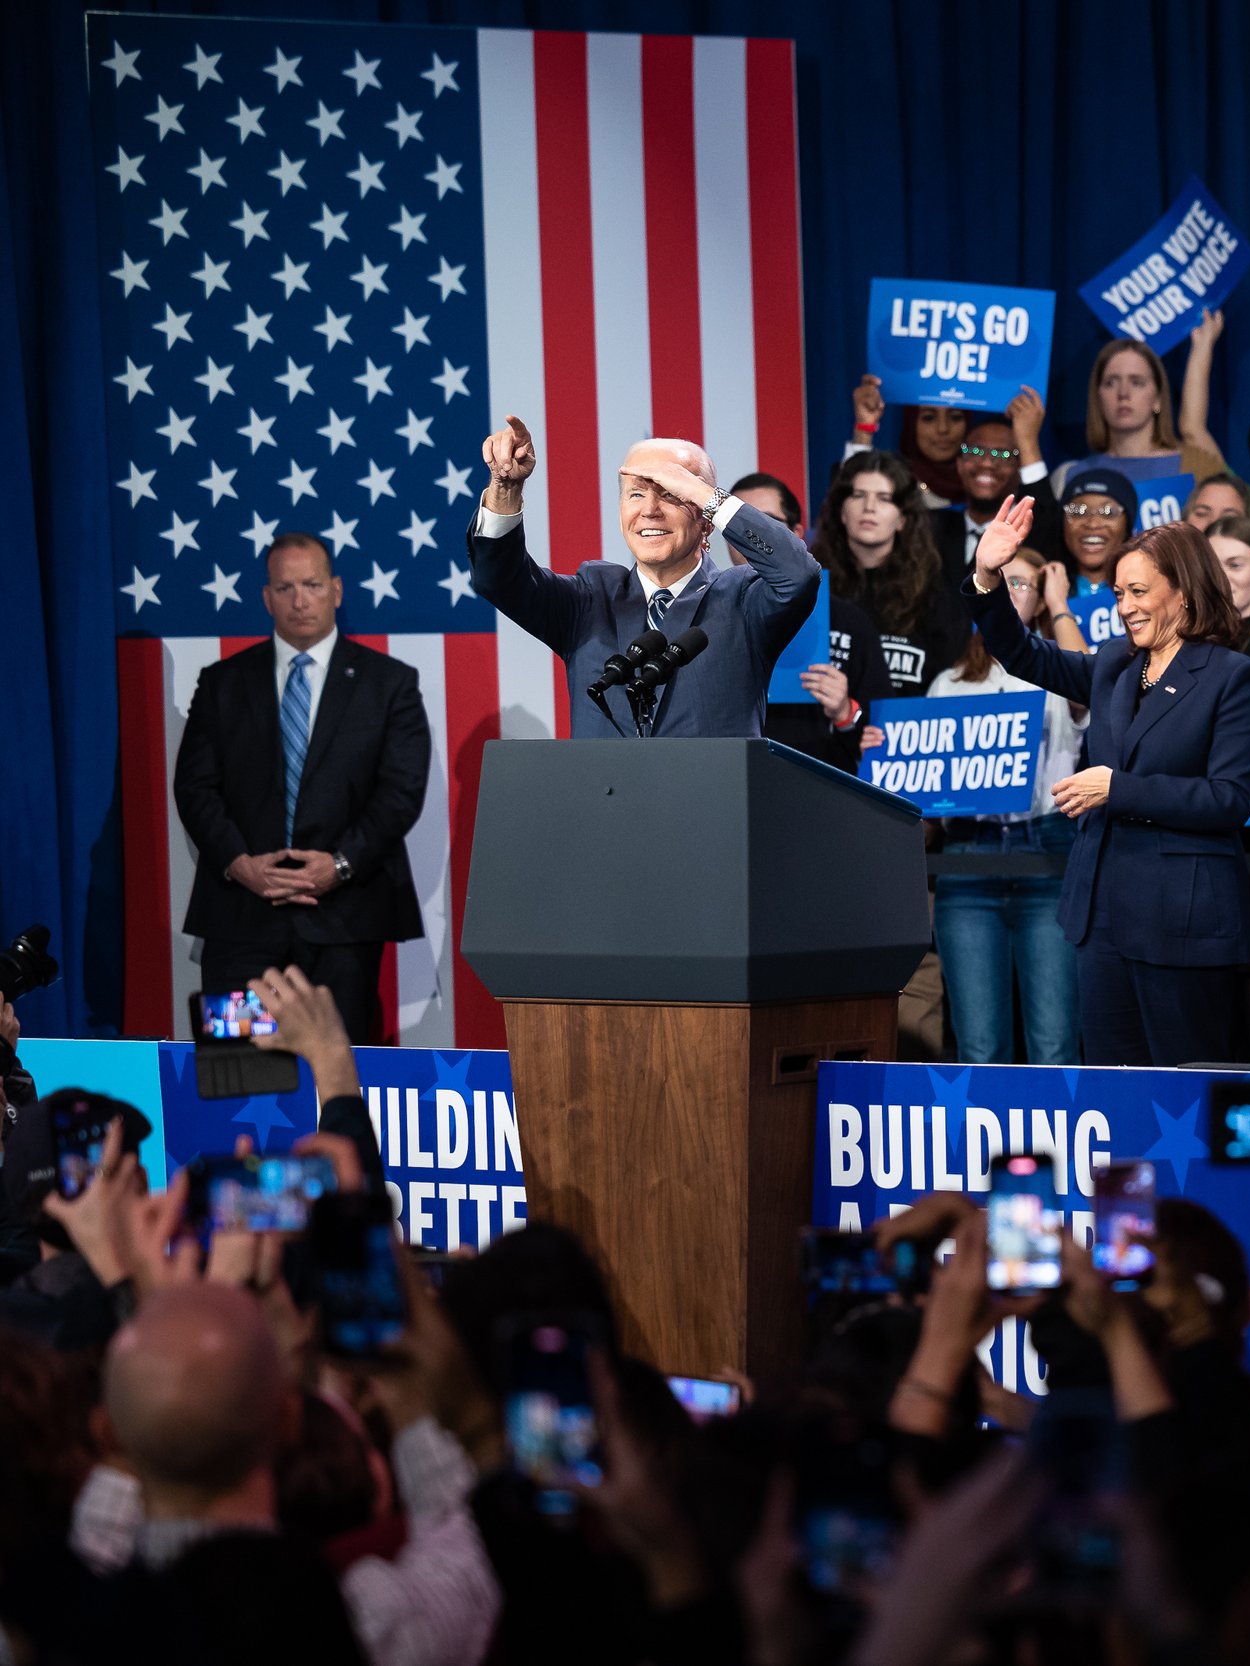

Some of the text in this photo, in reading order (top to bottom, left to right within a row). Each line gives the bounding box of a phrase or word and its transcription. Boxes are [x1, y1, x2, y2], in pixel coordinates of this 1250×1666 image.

[1101, 199, 1215, 314] YOUR VOTE
[1117, 221, 1239, 342] YOUR VOICE
[890, 298, 1030, 346] LET'S GO
[919, 340, 990, 383] JOE!
[1140, 495, 1181, 530] GO
[884, 711, 1030, 757] YOUR VOTE
[871, 751, 1031, 793] YOUR VOICE
[828, 1103, 1111, 1197] BUILDING
